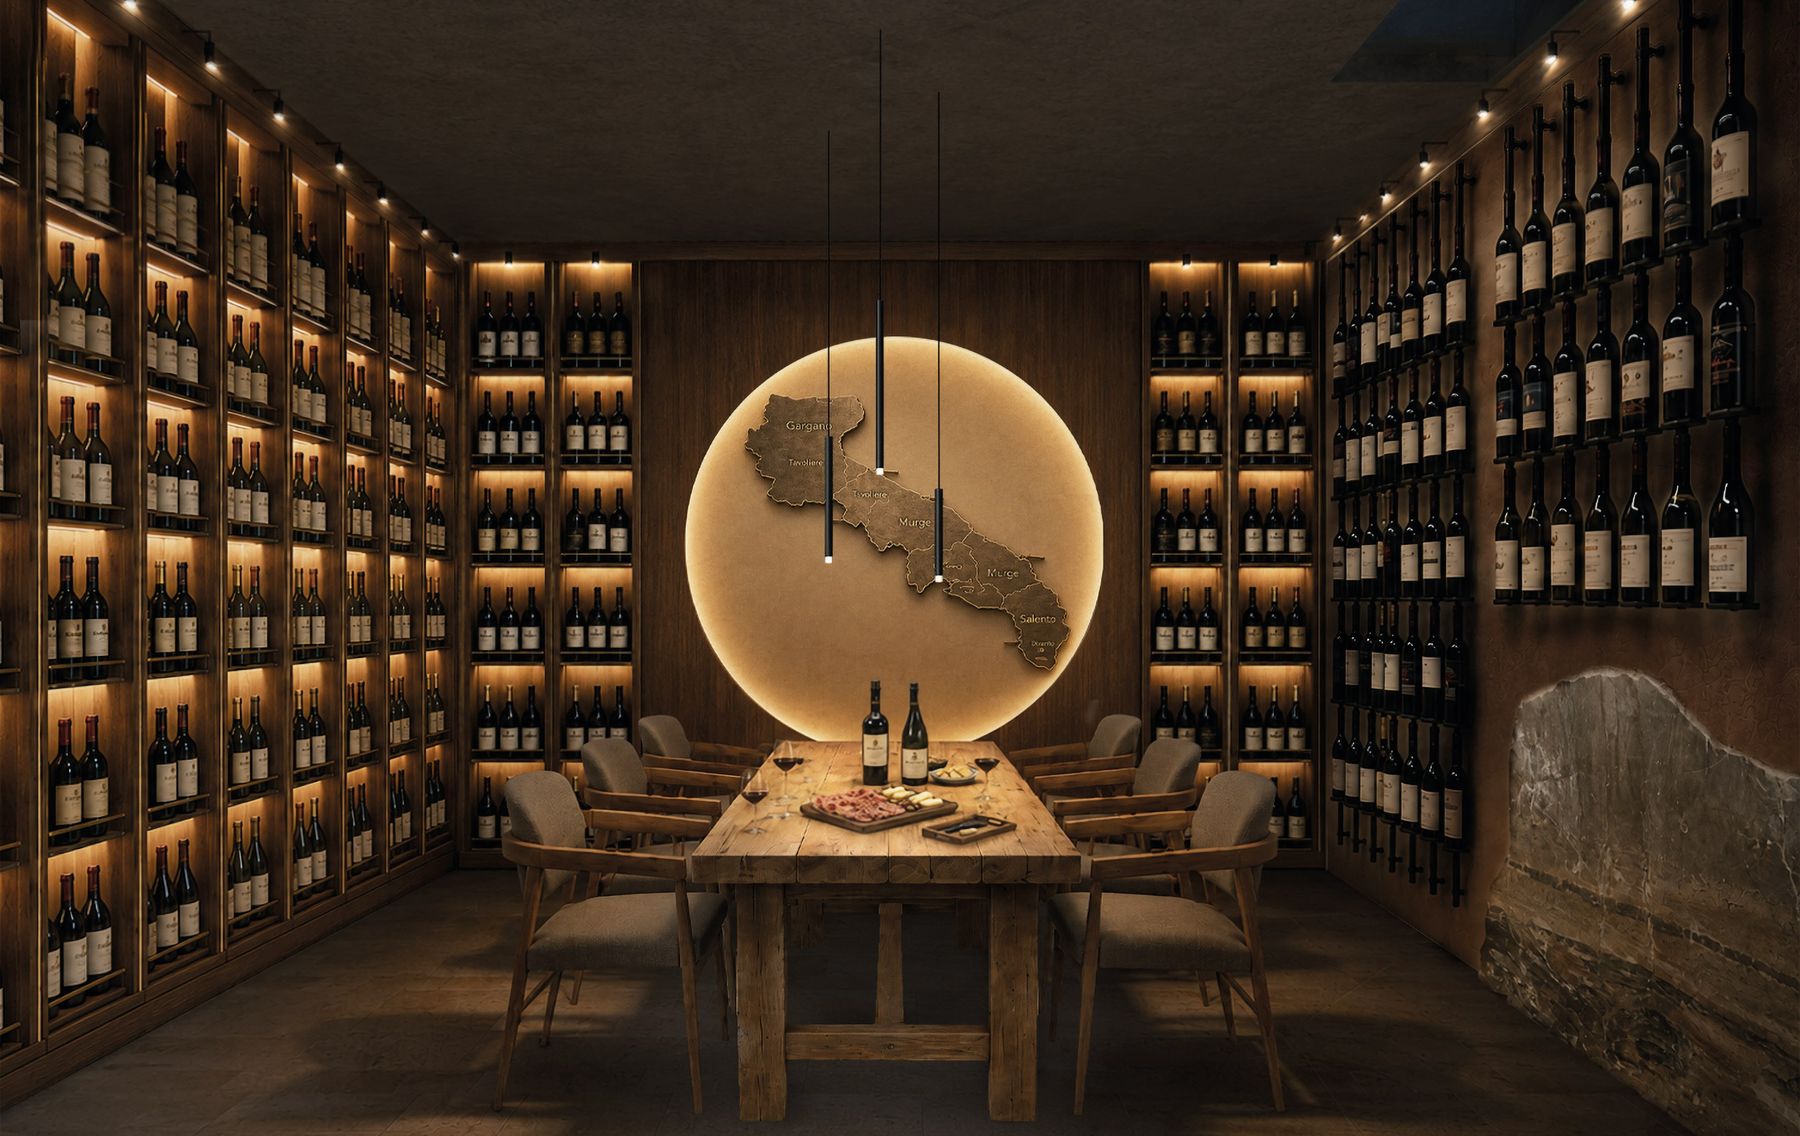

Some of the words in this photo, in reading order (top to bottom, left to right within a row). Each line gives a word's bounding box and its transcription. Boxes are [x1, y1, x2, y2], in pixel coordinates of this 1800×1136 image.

[785, 420, 833, 433] Gargano
[899, 517, 932, 529] Murge
[987, 568, 1020, 580] Murge
[1020, 614, 1056, 624] Salento
